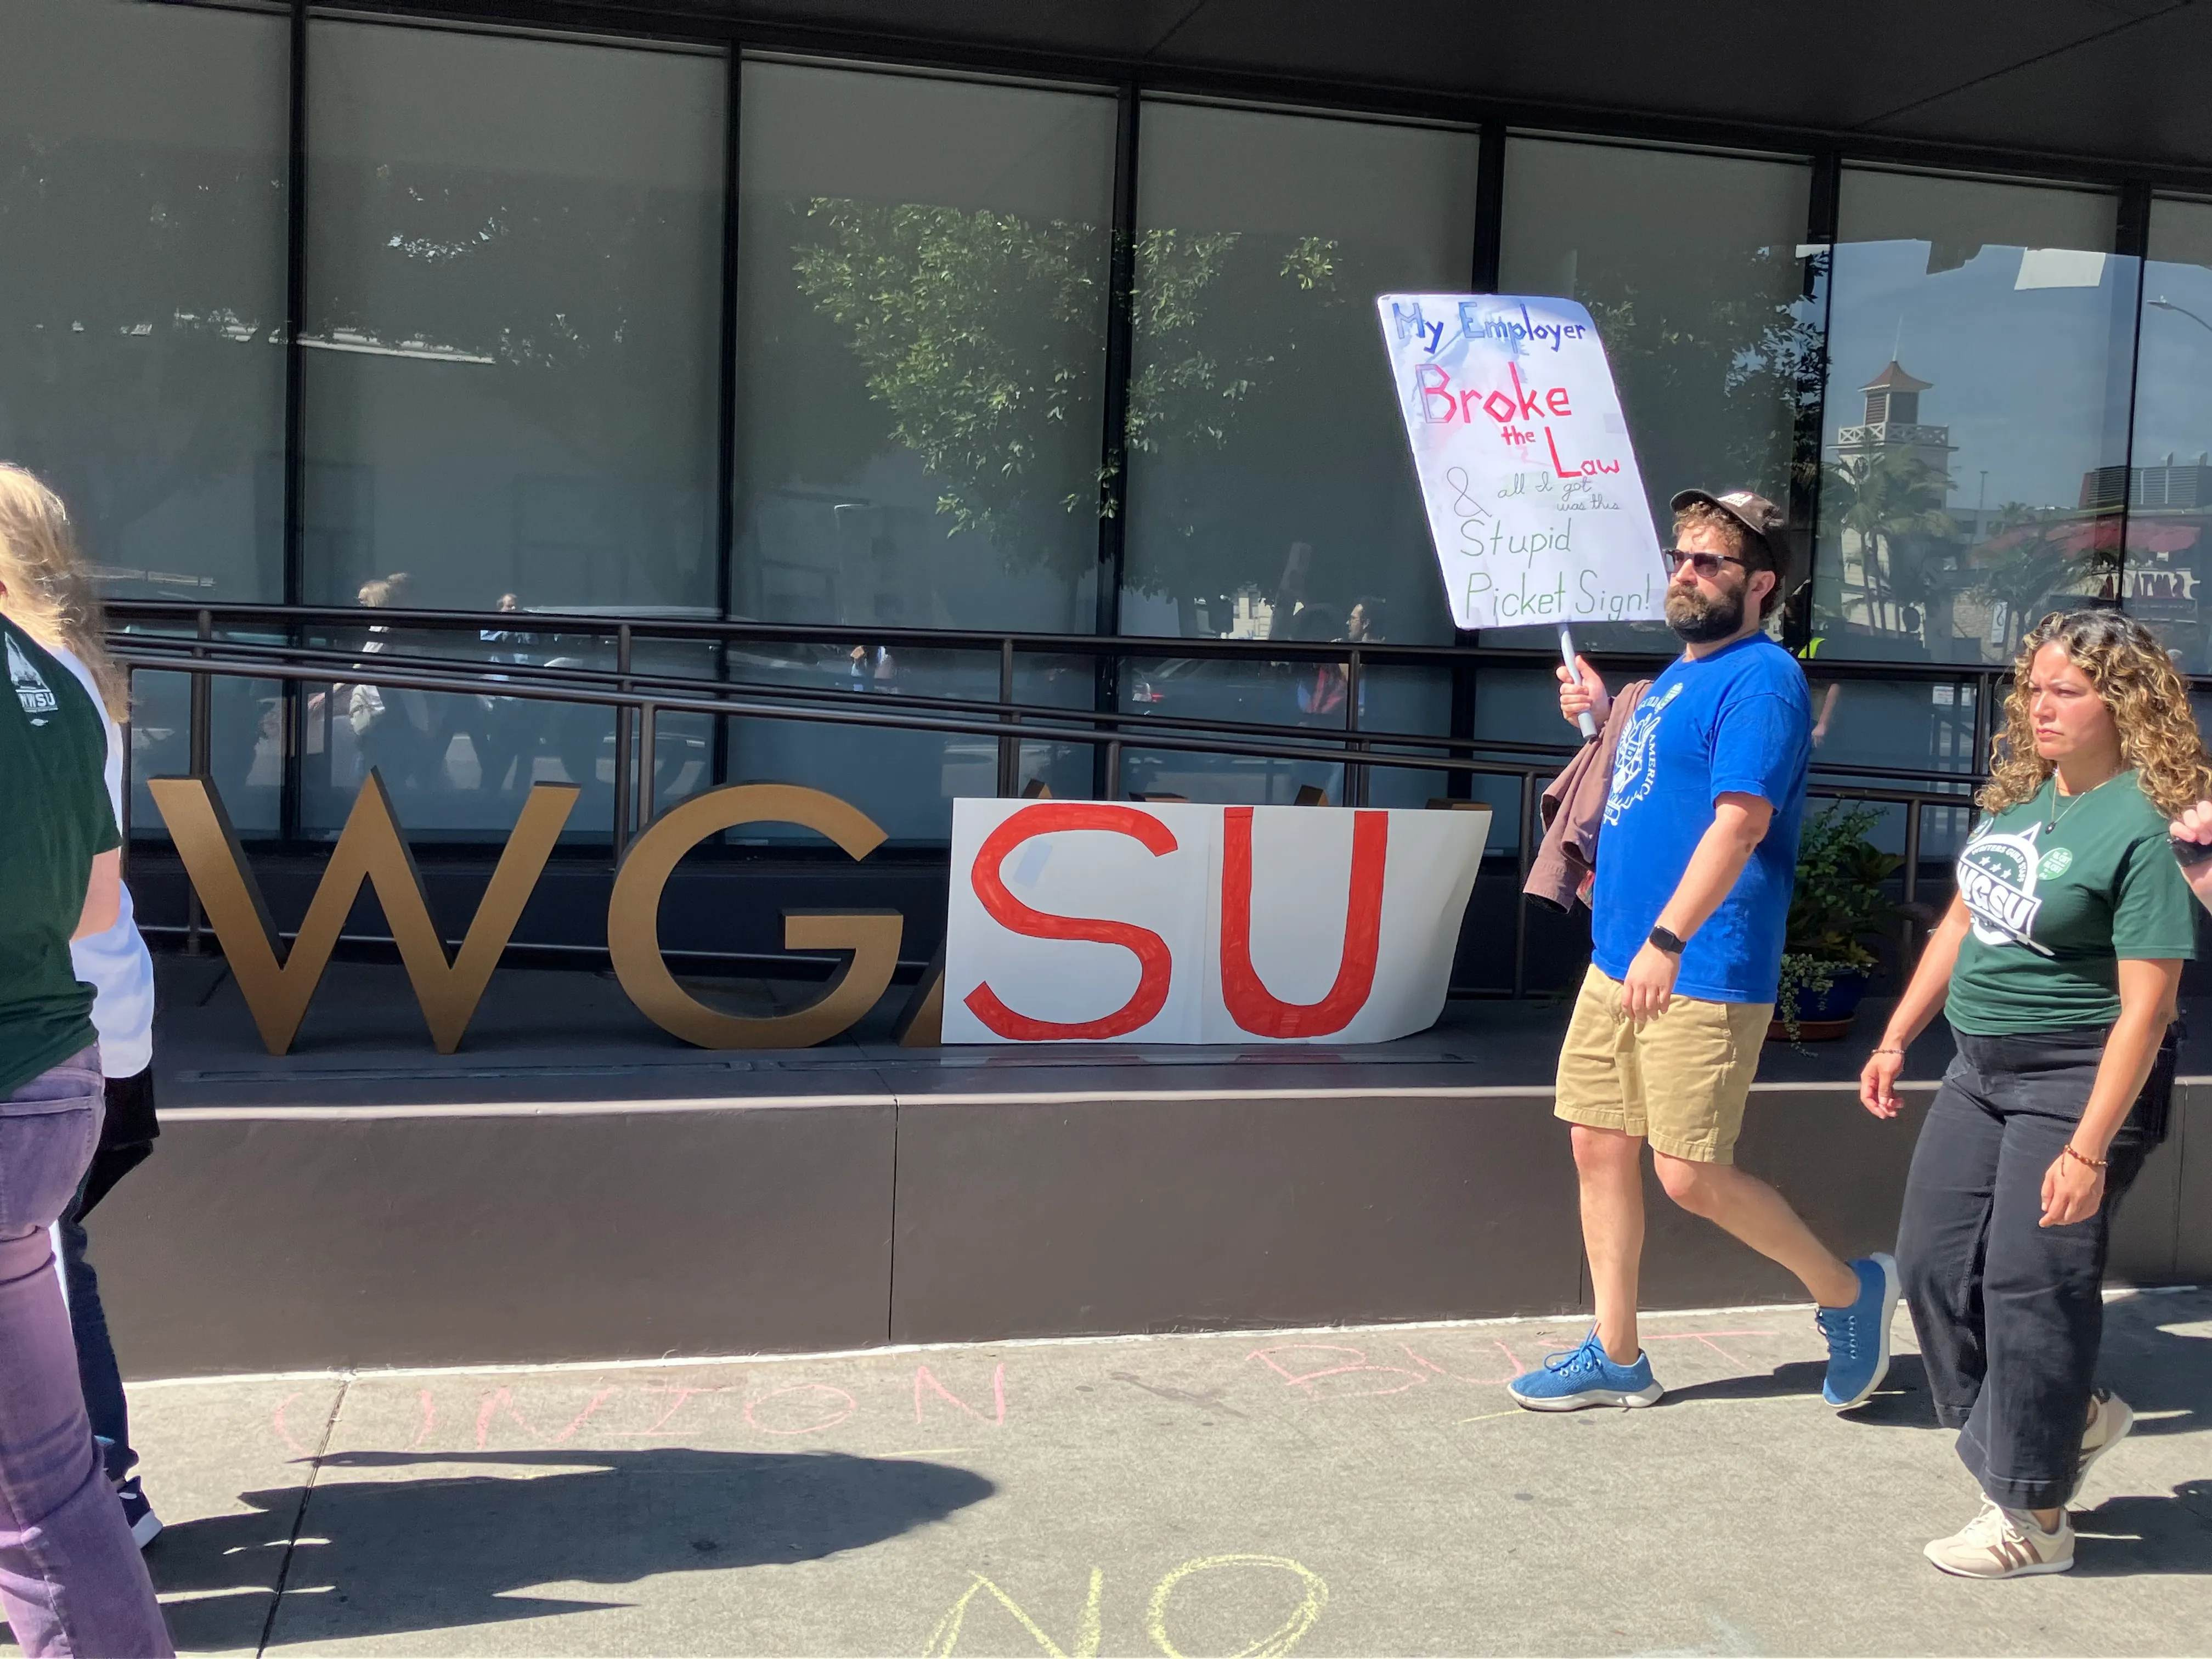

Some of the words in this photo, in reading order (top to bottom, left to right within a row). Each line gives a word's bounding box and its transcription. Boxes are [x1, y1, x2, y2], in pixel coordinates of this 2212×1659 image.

[1392, 301, 1443, 354] My
[1458, 301, 1587, 353] Employer
[1414, 361, 1572, 425] Broke
[1501, 426, 1536, 445] the
[1544, 426, 1620, 478] Law
[1446, 466, 1492, 518] &
[1497, 472, 1526, 499] all
[1562, 476, 1593, 501] got
[1556, 500, 1585, 511] was
[1590, 493, 1620, 511] this
[1460, 517, 1572, 569] Stupid
[1465, 572, 1565, 619] Picket
[1575, 569, 1651, 622] Sign!
[1633, 733, 1657, 802] AMERICA
[2005, 848, 2024, 864] GUILD
[1957, 861, 2035, 929] WGSU
[272, 1361, 1007, 1456] UNION
[923, 1553, 1329, 1658] NO
